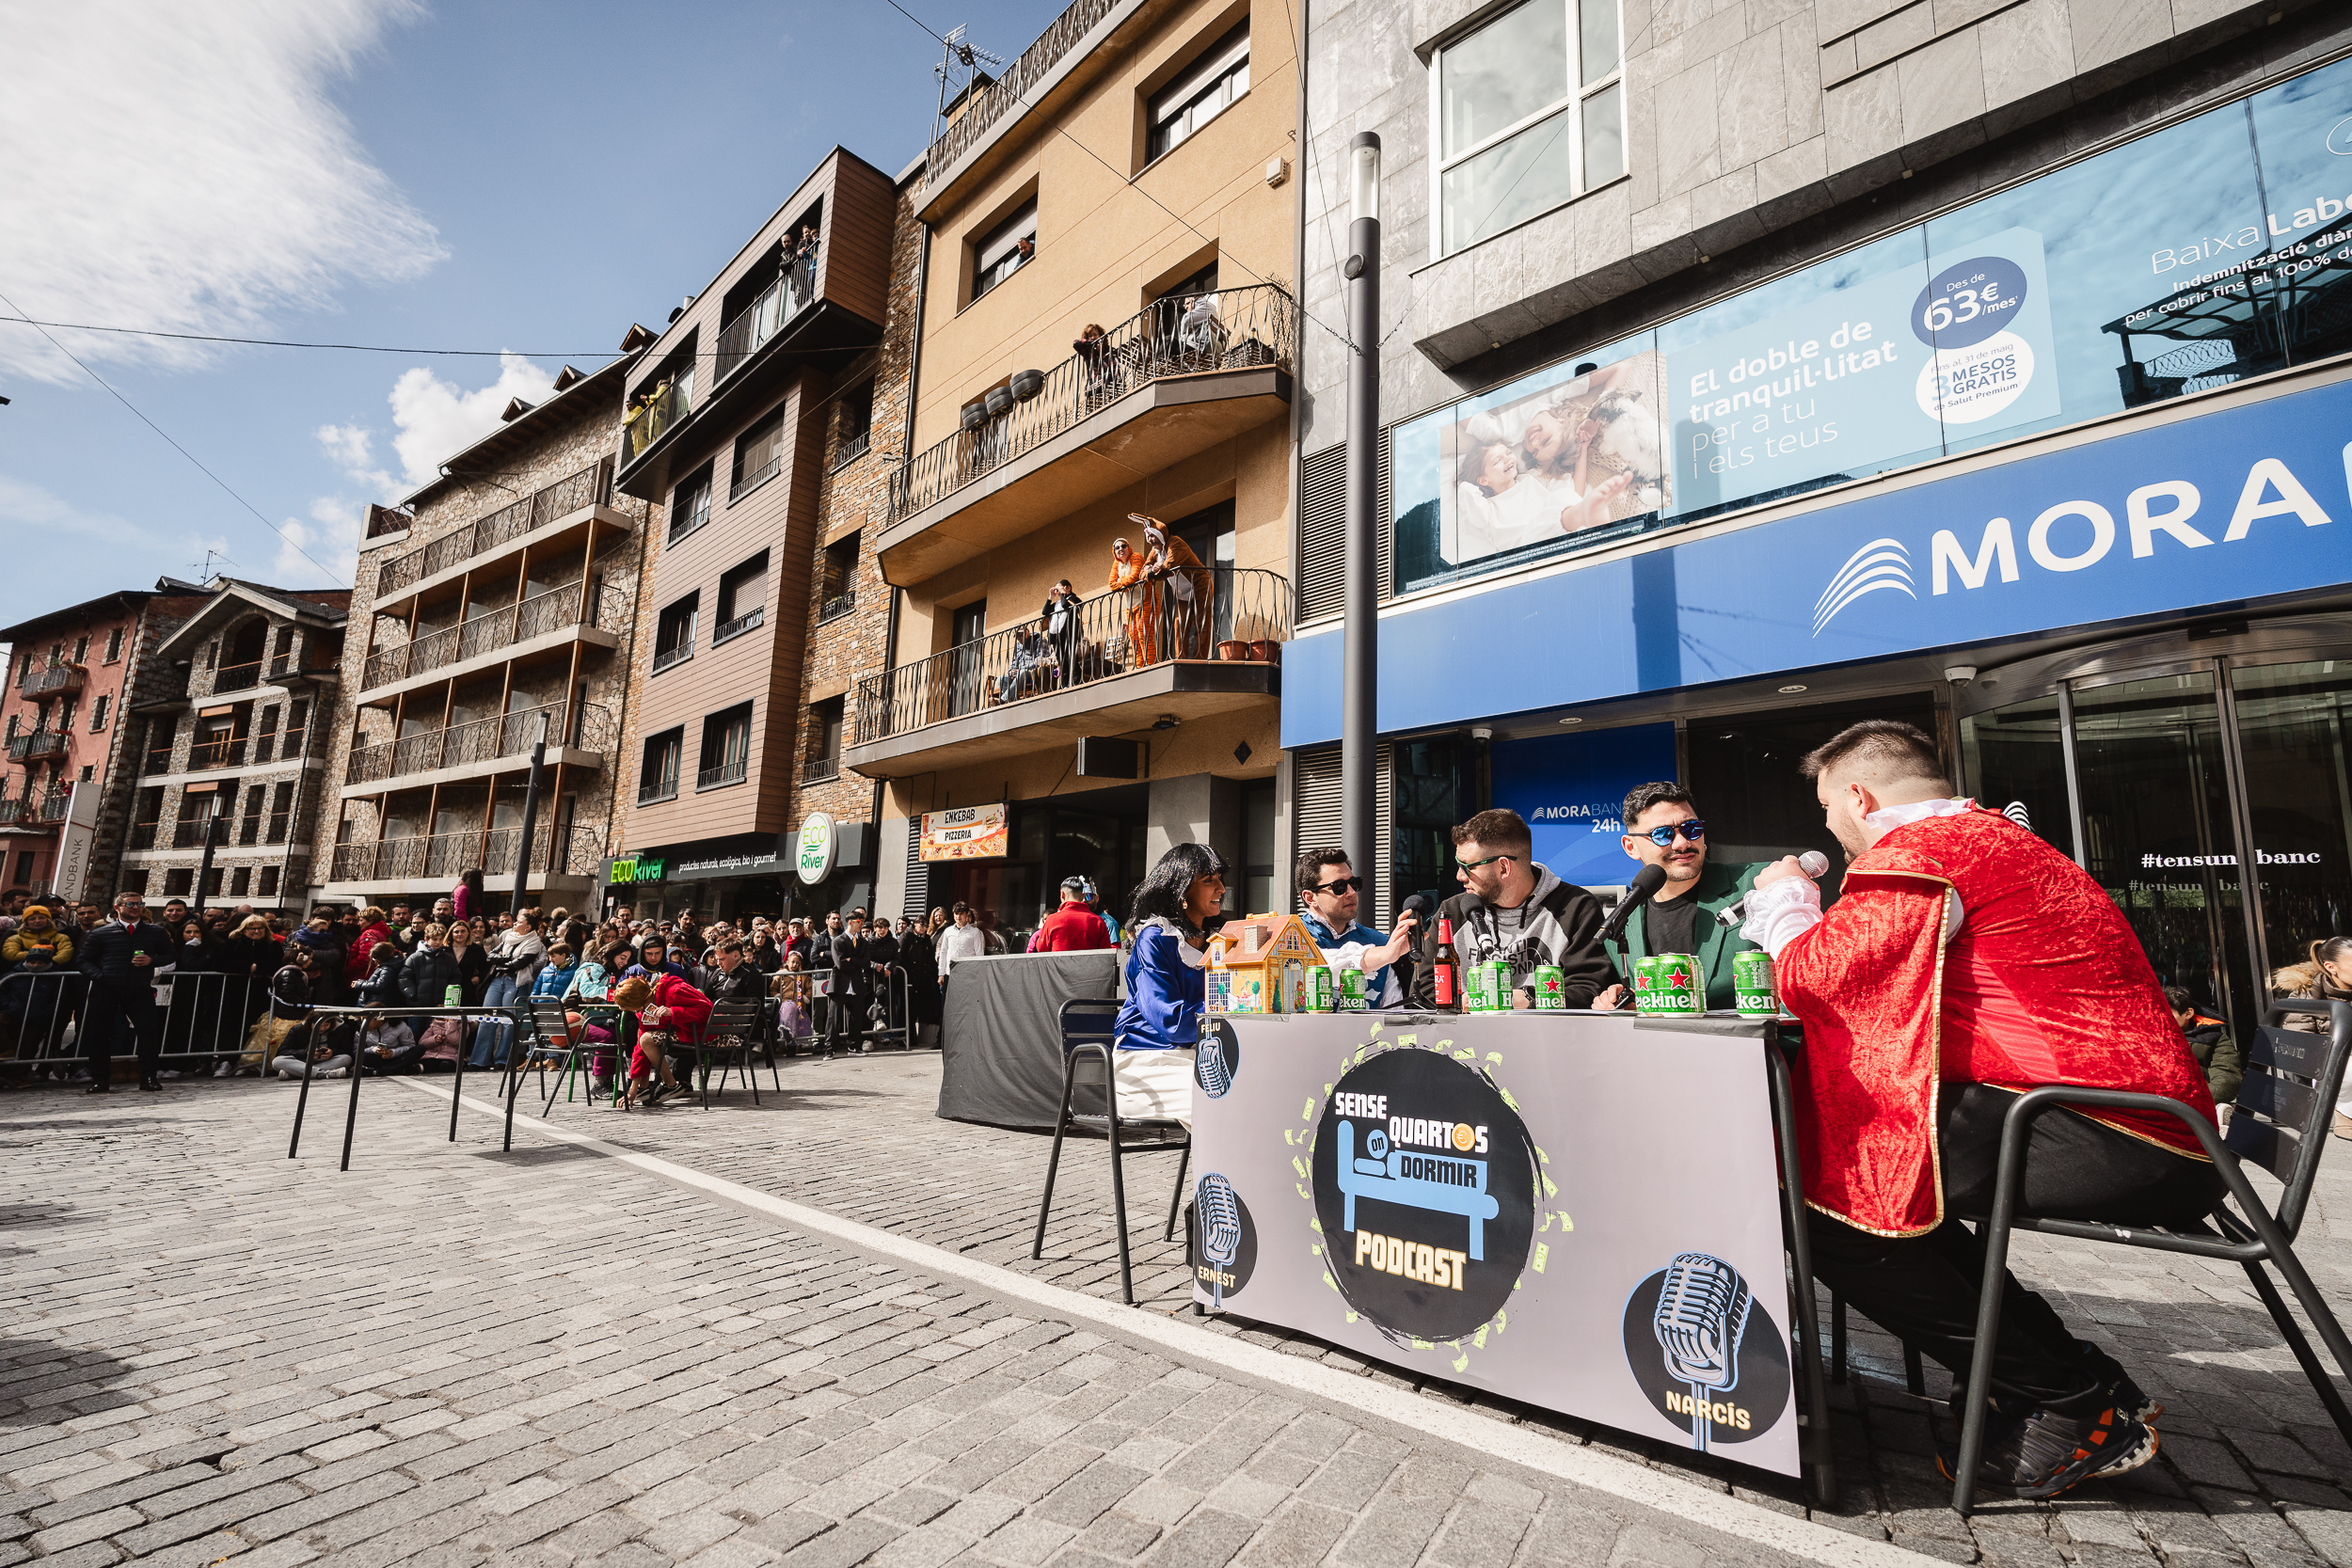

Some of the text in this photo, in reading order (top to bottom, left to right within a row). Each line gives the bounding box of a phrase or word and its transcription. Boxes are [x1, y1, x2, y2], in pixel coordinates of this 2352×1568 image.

[2151, 194, 2352, 275] Baixa Lab
[2172, 242, 2308, 293] Indemnització
[1947, 273, 1985, 293] Des de
[2125, 309, 2153, 327] per
[2158, 293, 2208, 314] cobrir
[2212, 280, 2247, 298] fins
[2252, 271, 2272, 286] al
[2276, 254, 2331, 278] 100%
[1923, 282, 1999, 331] 63€
[1691, 321, 1872, 398] El doble de
[1977, 351, 1988, 360] de
[1991, 343, 2013, 356] maig
[1931, 355, 2015, 401] 3 MESOS
[1953, 368, 2017, 394] GRATIS
[1947, 396, 1973, 407] Salut
[1692, 399, 1815, 458] per a tu
[1693, 421, 1838, 480] i els teus
[1931, 442, 2352, 596] MORA
[945, 808, 976, 824] ENKEBAB
[1547, 801, 1623, 818] MORABAN
[803, 825, 827, 846] ECO
[945, 829, 972, 842] PIZZERIA
[1592, 818, 1620, 832] 24h
[64, 838, 84, 900] ANDBANK
[678, 860, 699, 875] productes
[742, 854, 751, 865] bio
[754, 850, 777, 867] gourmet
[801, 853, 825, 870] River
[2255, 849, 2321, 864] banc
[1200, 1022, 1221, 1034] FELIU
[1335, 1092, 1388, 1119] SENSE
[1401, 1154, 1477, 1189] DORMIR
[1355, 1228, 1467, 1291] PODCAST
[1198, 1265, 1236, 1289] ERNEST
